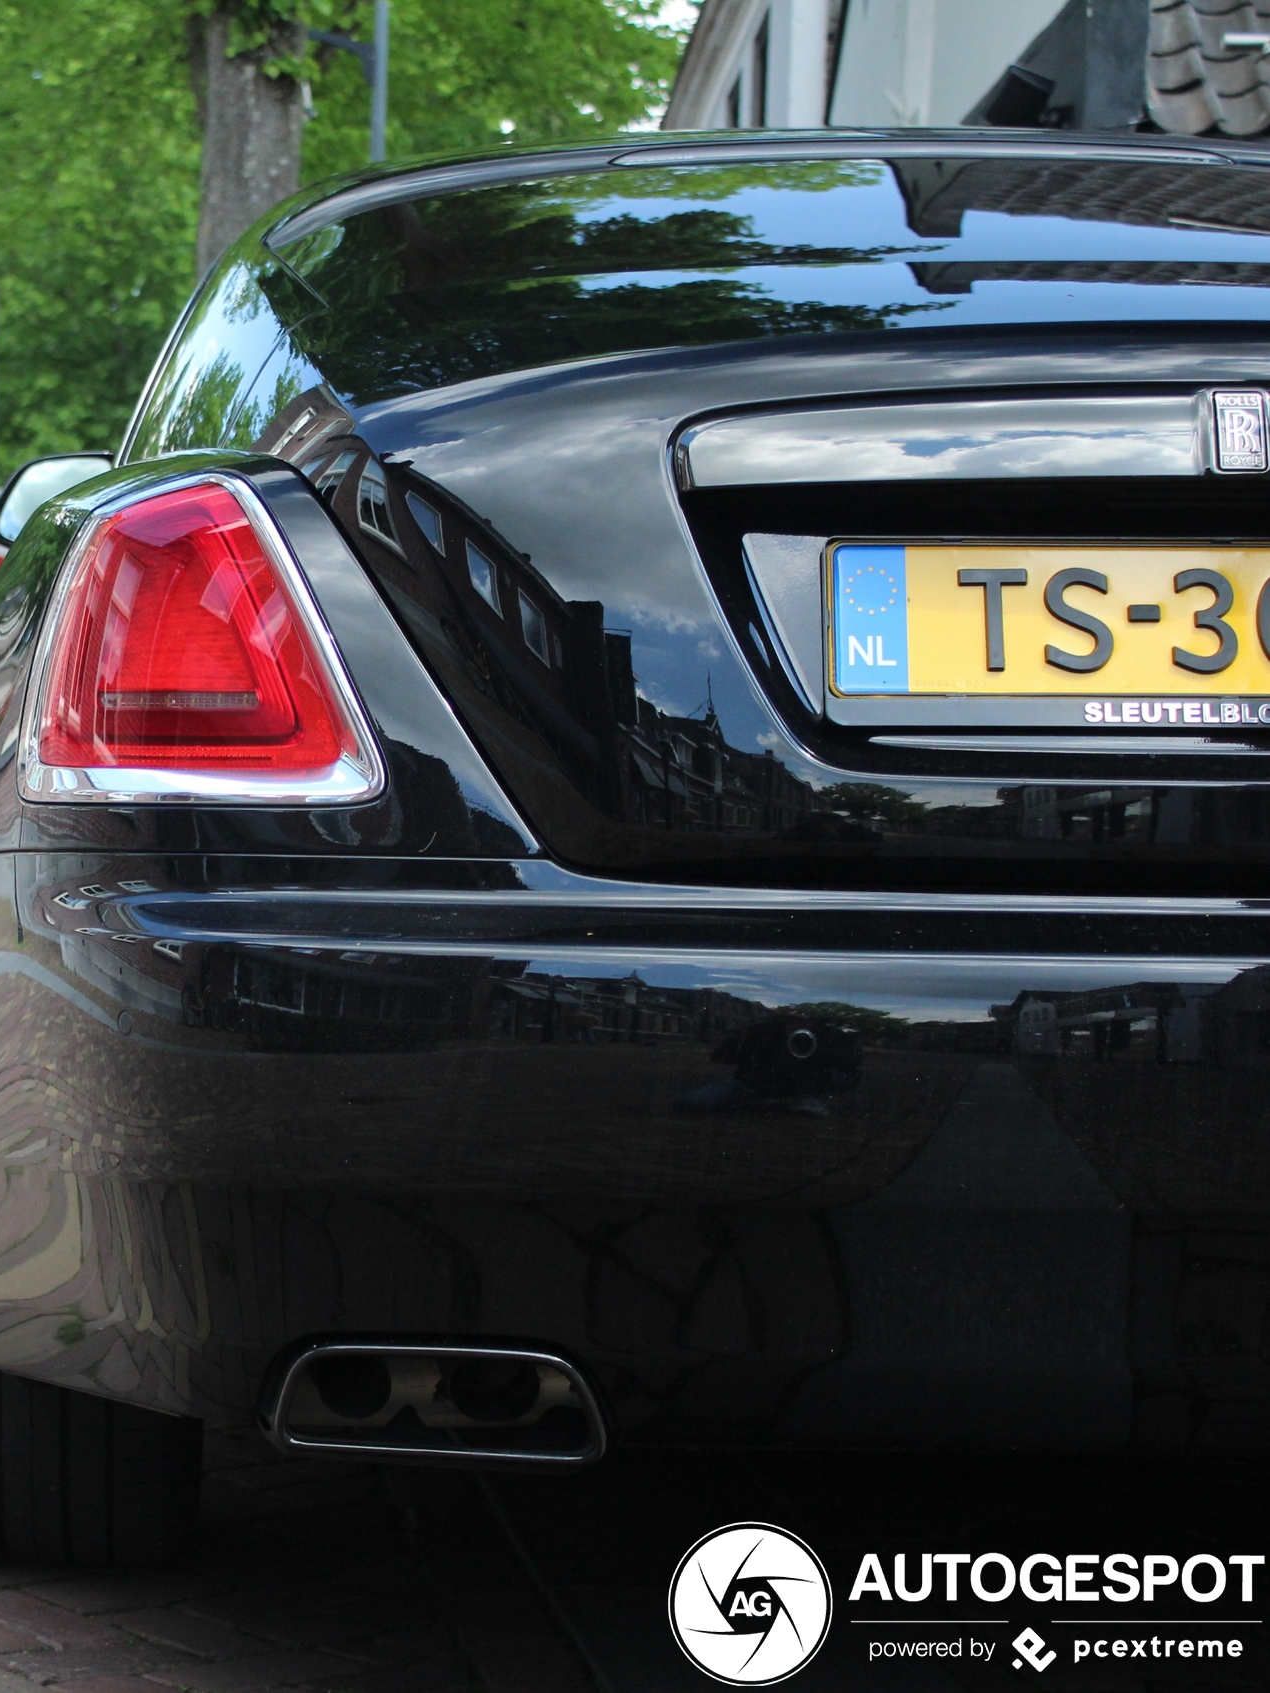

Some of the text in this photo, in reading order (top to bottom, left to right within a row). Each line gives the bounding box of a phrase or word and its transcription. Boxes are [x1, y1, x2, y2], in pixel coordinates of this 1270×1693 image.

[1219, 396, 1257, 406] ROLLS
[1223, 409, 1261, 452] RR
[1223, 455, 1263, 466] ROYCE
[957, 567, 1270, 675] TS-3
[848, 635, 897, 666] NL
